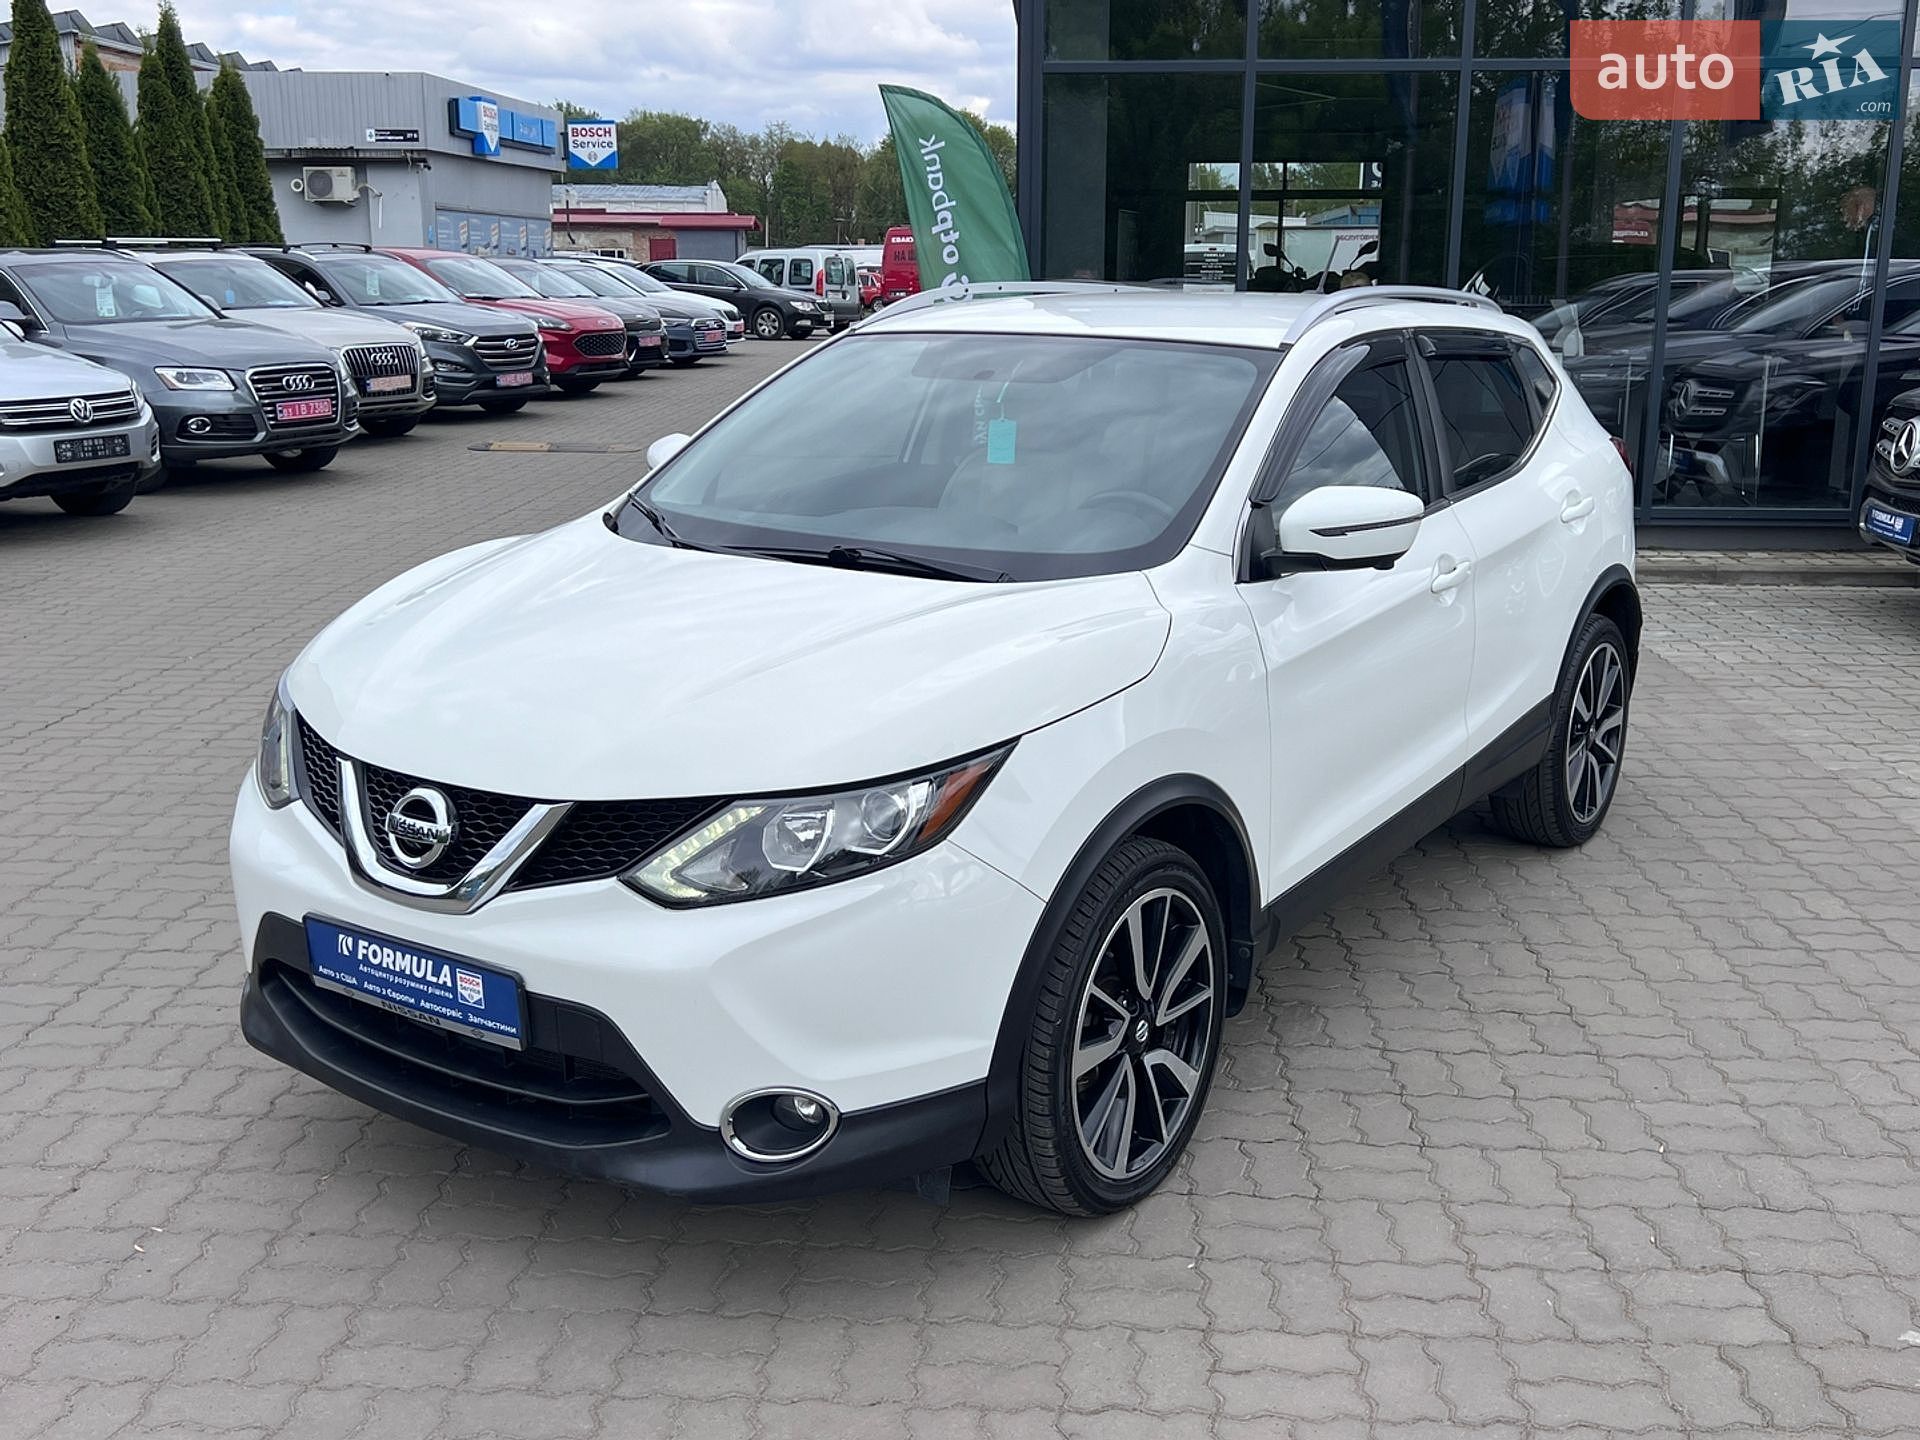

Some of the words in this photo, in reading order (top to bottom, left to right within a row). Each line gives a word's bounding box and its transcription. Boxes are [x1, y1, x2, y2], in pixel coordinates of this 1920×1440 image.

[571, 127, 612, 138] BOSCH
[572, 139, 614, 149] Service
[389, 815, 440, 841] NISSAN
[358, 939, 452, 987] FORMULA
[359, 963, 394, 982] Автоцентр
[459, 975, 480, 988] BOSCH
[319, 965, 335, 977] Авто
[341, 972, 358, 985] США
[363, 981, 381, 994] Авто
[387, 988, 416, 1005] Європи
[420, 999, 463, 1019] Автосервіс
[468, 1013, 517, 1034] Запчастини
[380, 1000, 441, 1026] NISSAN
